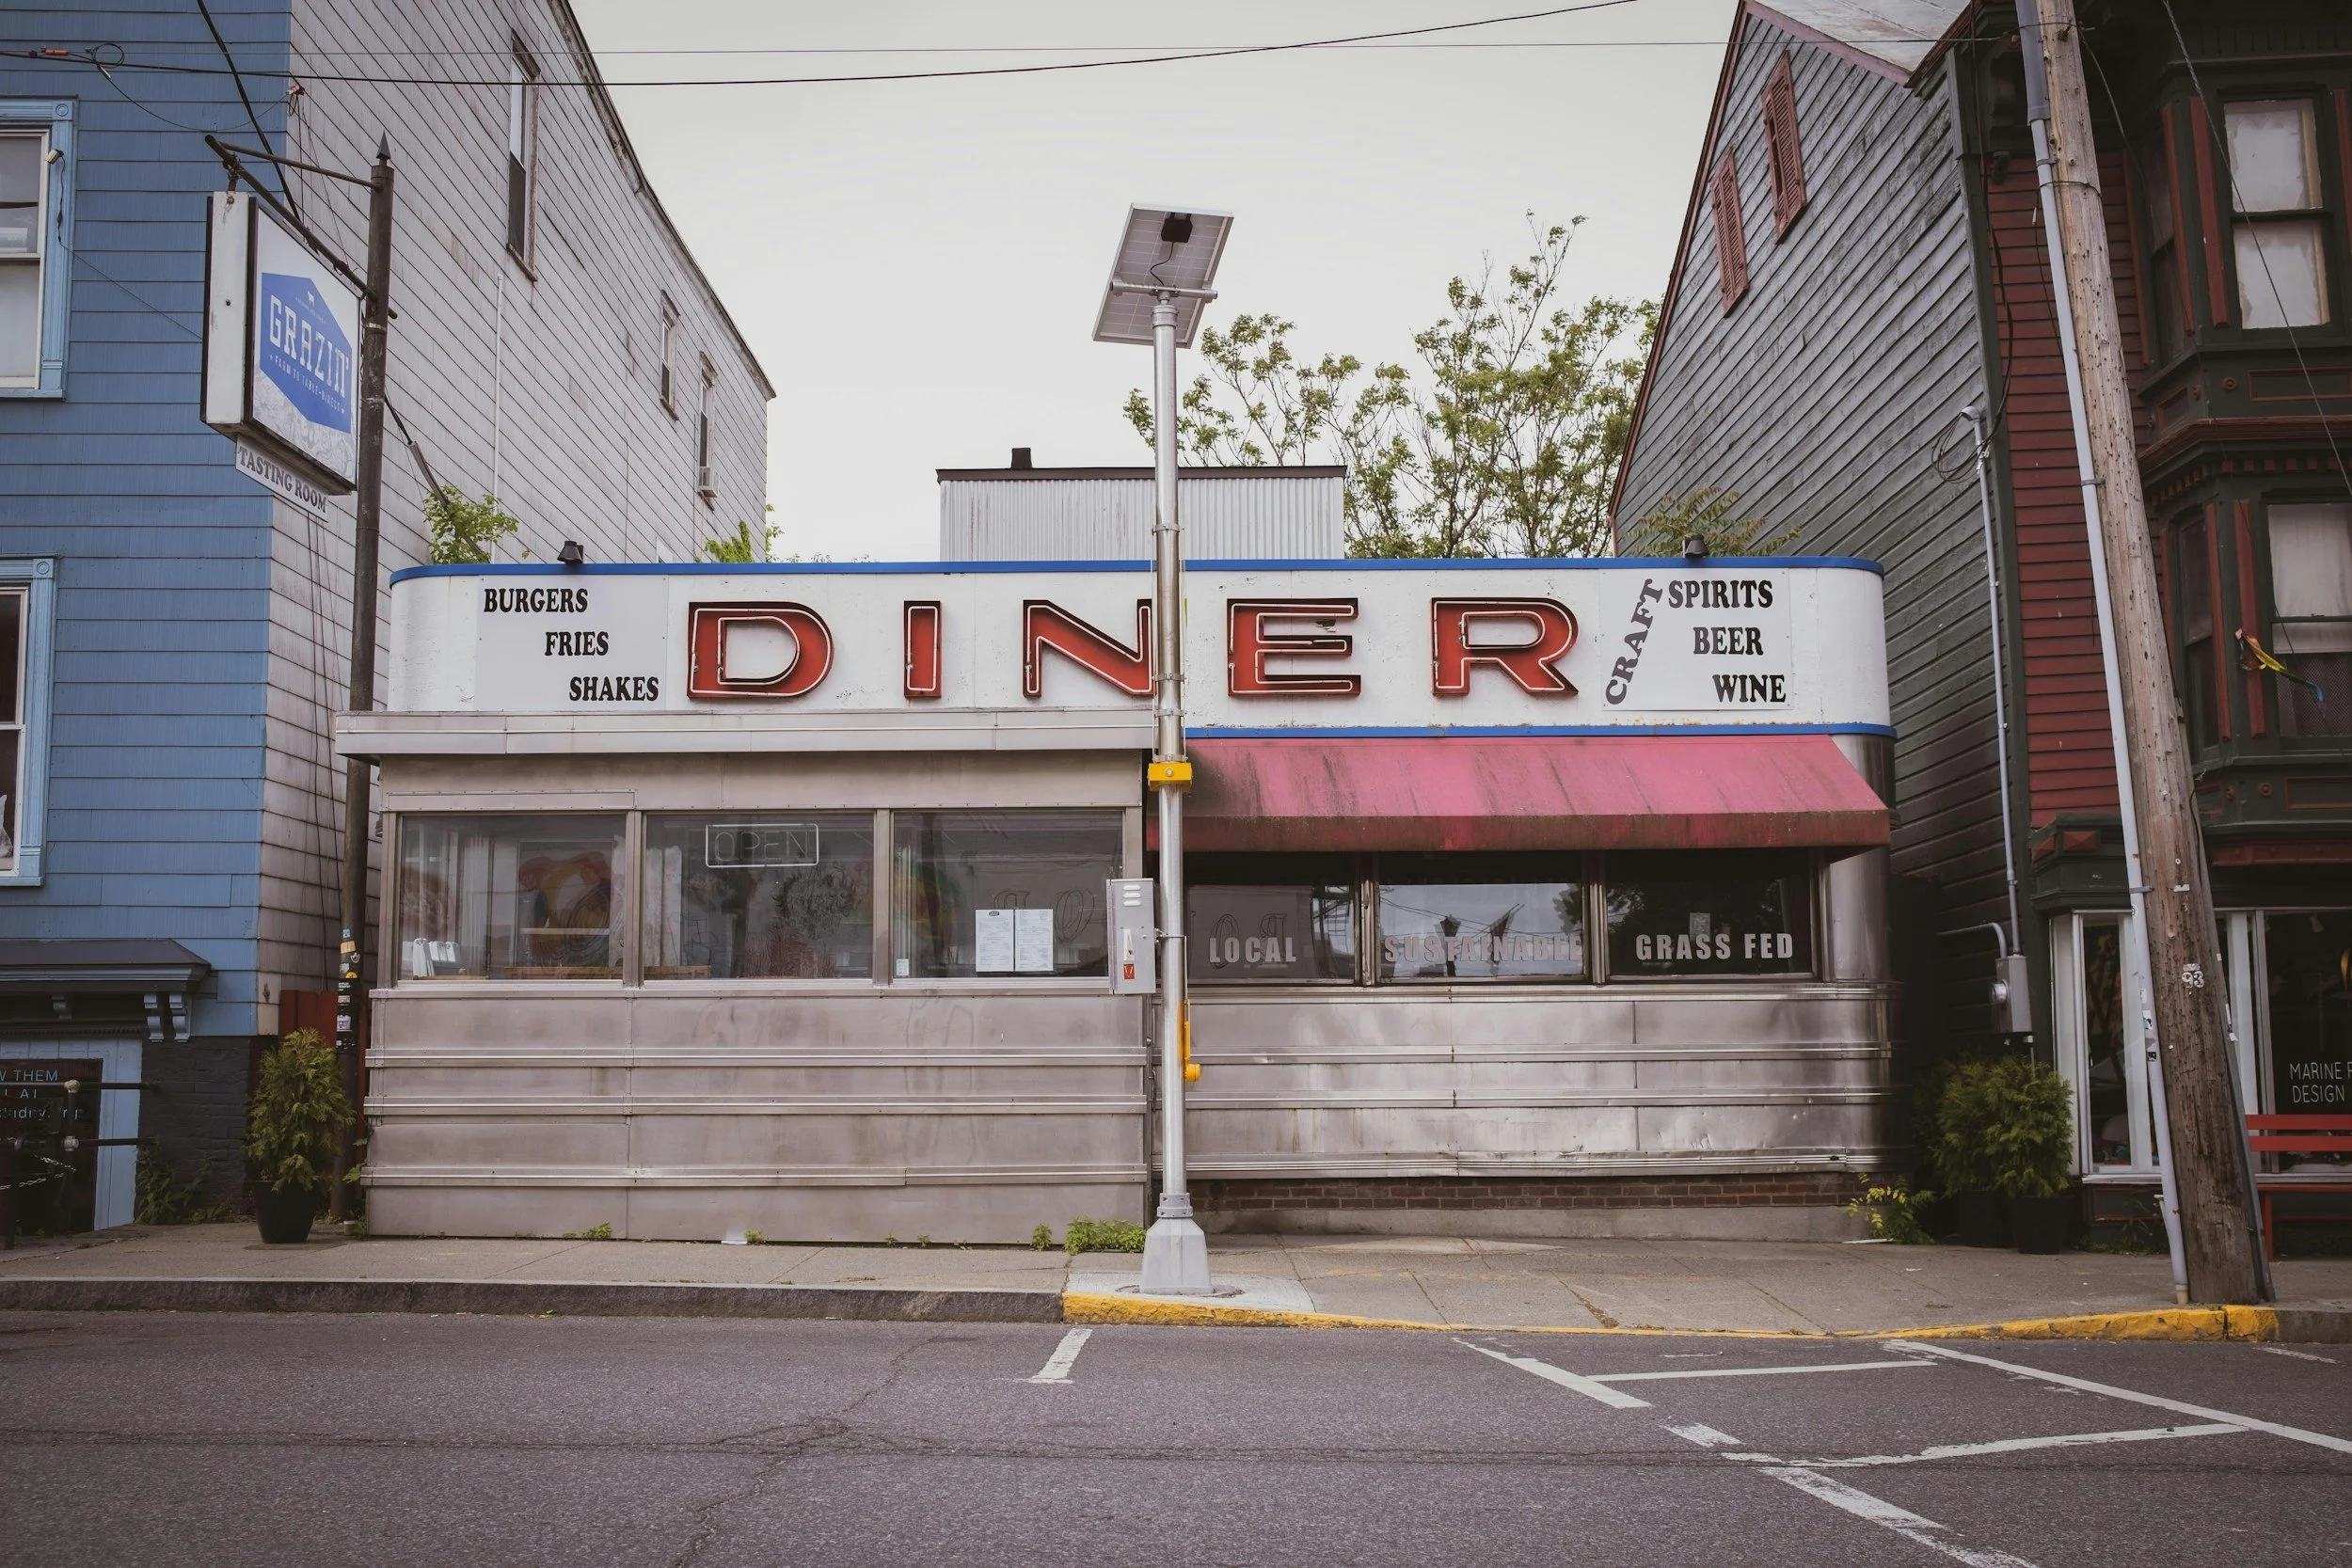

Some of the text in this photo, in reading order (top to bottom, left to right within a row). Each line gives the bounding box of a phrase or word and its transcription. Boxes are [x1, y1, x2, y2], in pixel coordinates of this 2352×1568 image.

[237, 446, 327, 514] TASTING ROOM
[484, 588, 588, 613] BURGERS
[1668, 579, 1773, 610] SPIRITS
[545, 631, 610, 657] FRIES
[687, 597, 1580, 700] DINER
[1605, 578, 1663, 705] CRAFT
[1693, 626, 1764, 656] BEER
[569, 676, 660, 702] SHAKES
[1712, 674, 1787, 704] WINE
[715, 831, 809, 862] OPEN
[1209, 937, 1297, 963] LOCAL
[1384, 935, 1582, 962] SUSTAINABLE
[1635, 933, 1794, 960] GRASS FED
[2182, 971, 2205, 989] 93
[14, 1069, 58, 1082] THEM
[2289, 1062, 2343, 1080] MARINE
[2293, 1085, 2345, 1102] DESIGN
